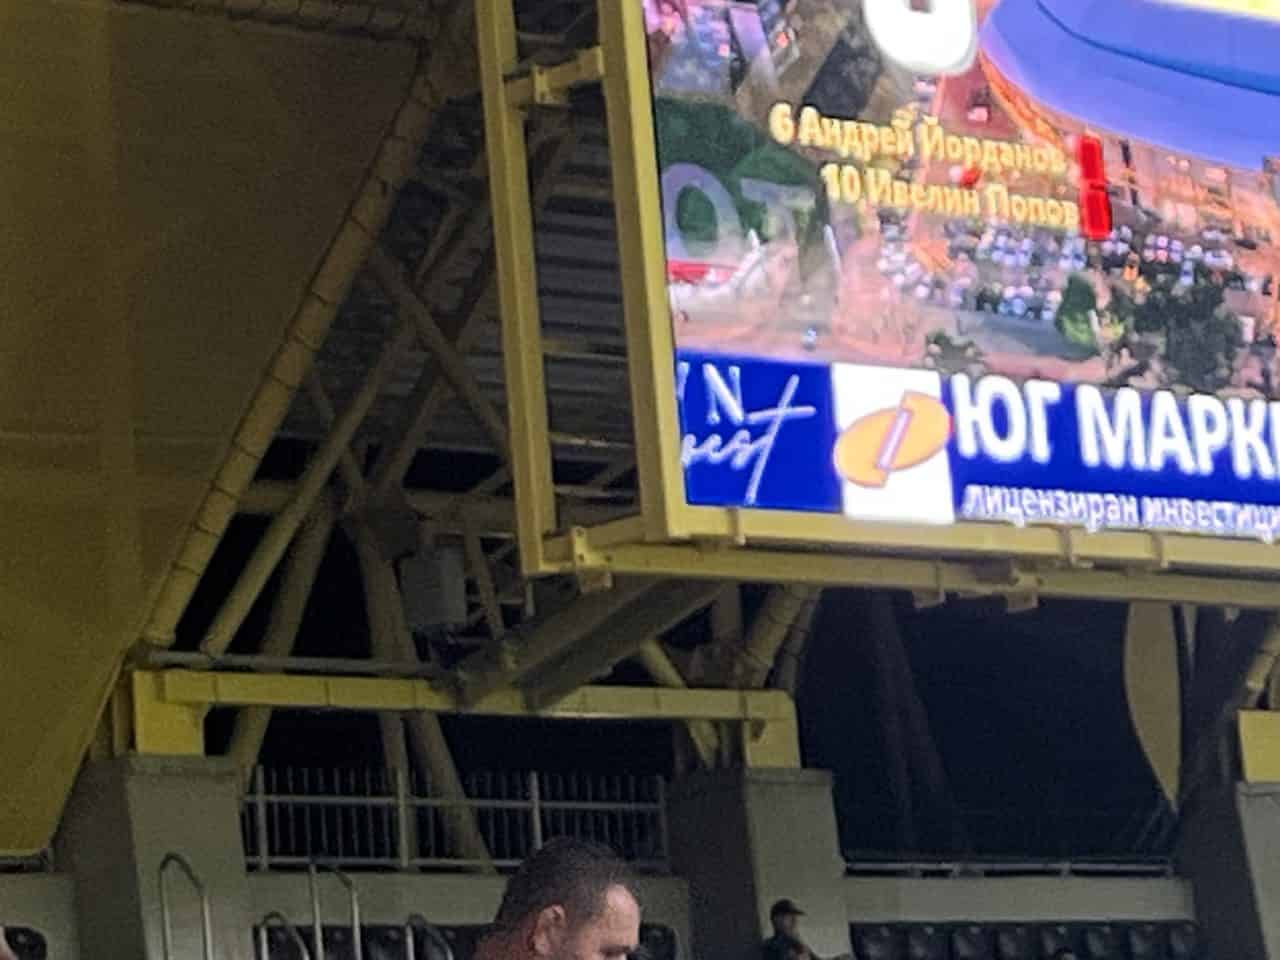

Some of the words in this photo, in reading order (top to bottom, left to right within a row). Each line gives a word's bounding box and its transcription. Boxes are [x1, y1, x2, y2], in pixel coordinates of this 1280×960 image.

[768, 101, 795, 143] 6
[798, 102, 916, 163] Андрей
[821, 163, 862, 204] 10
[865, 168, 980, 214] Ивелин
[950, 373, 1061, 464] ЮГ
[961, 484, 1140, 533] лицензиран
